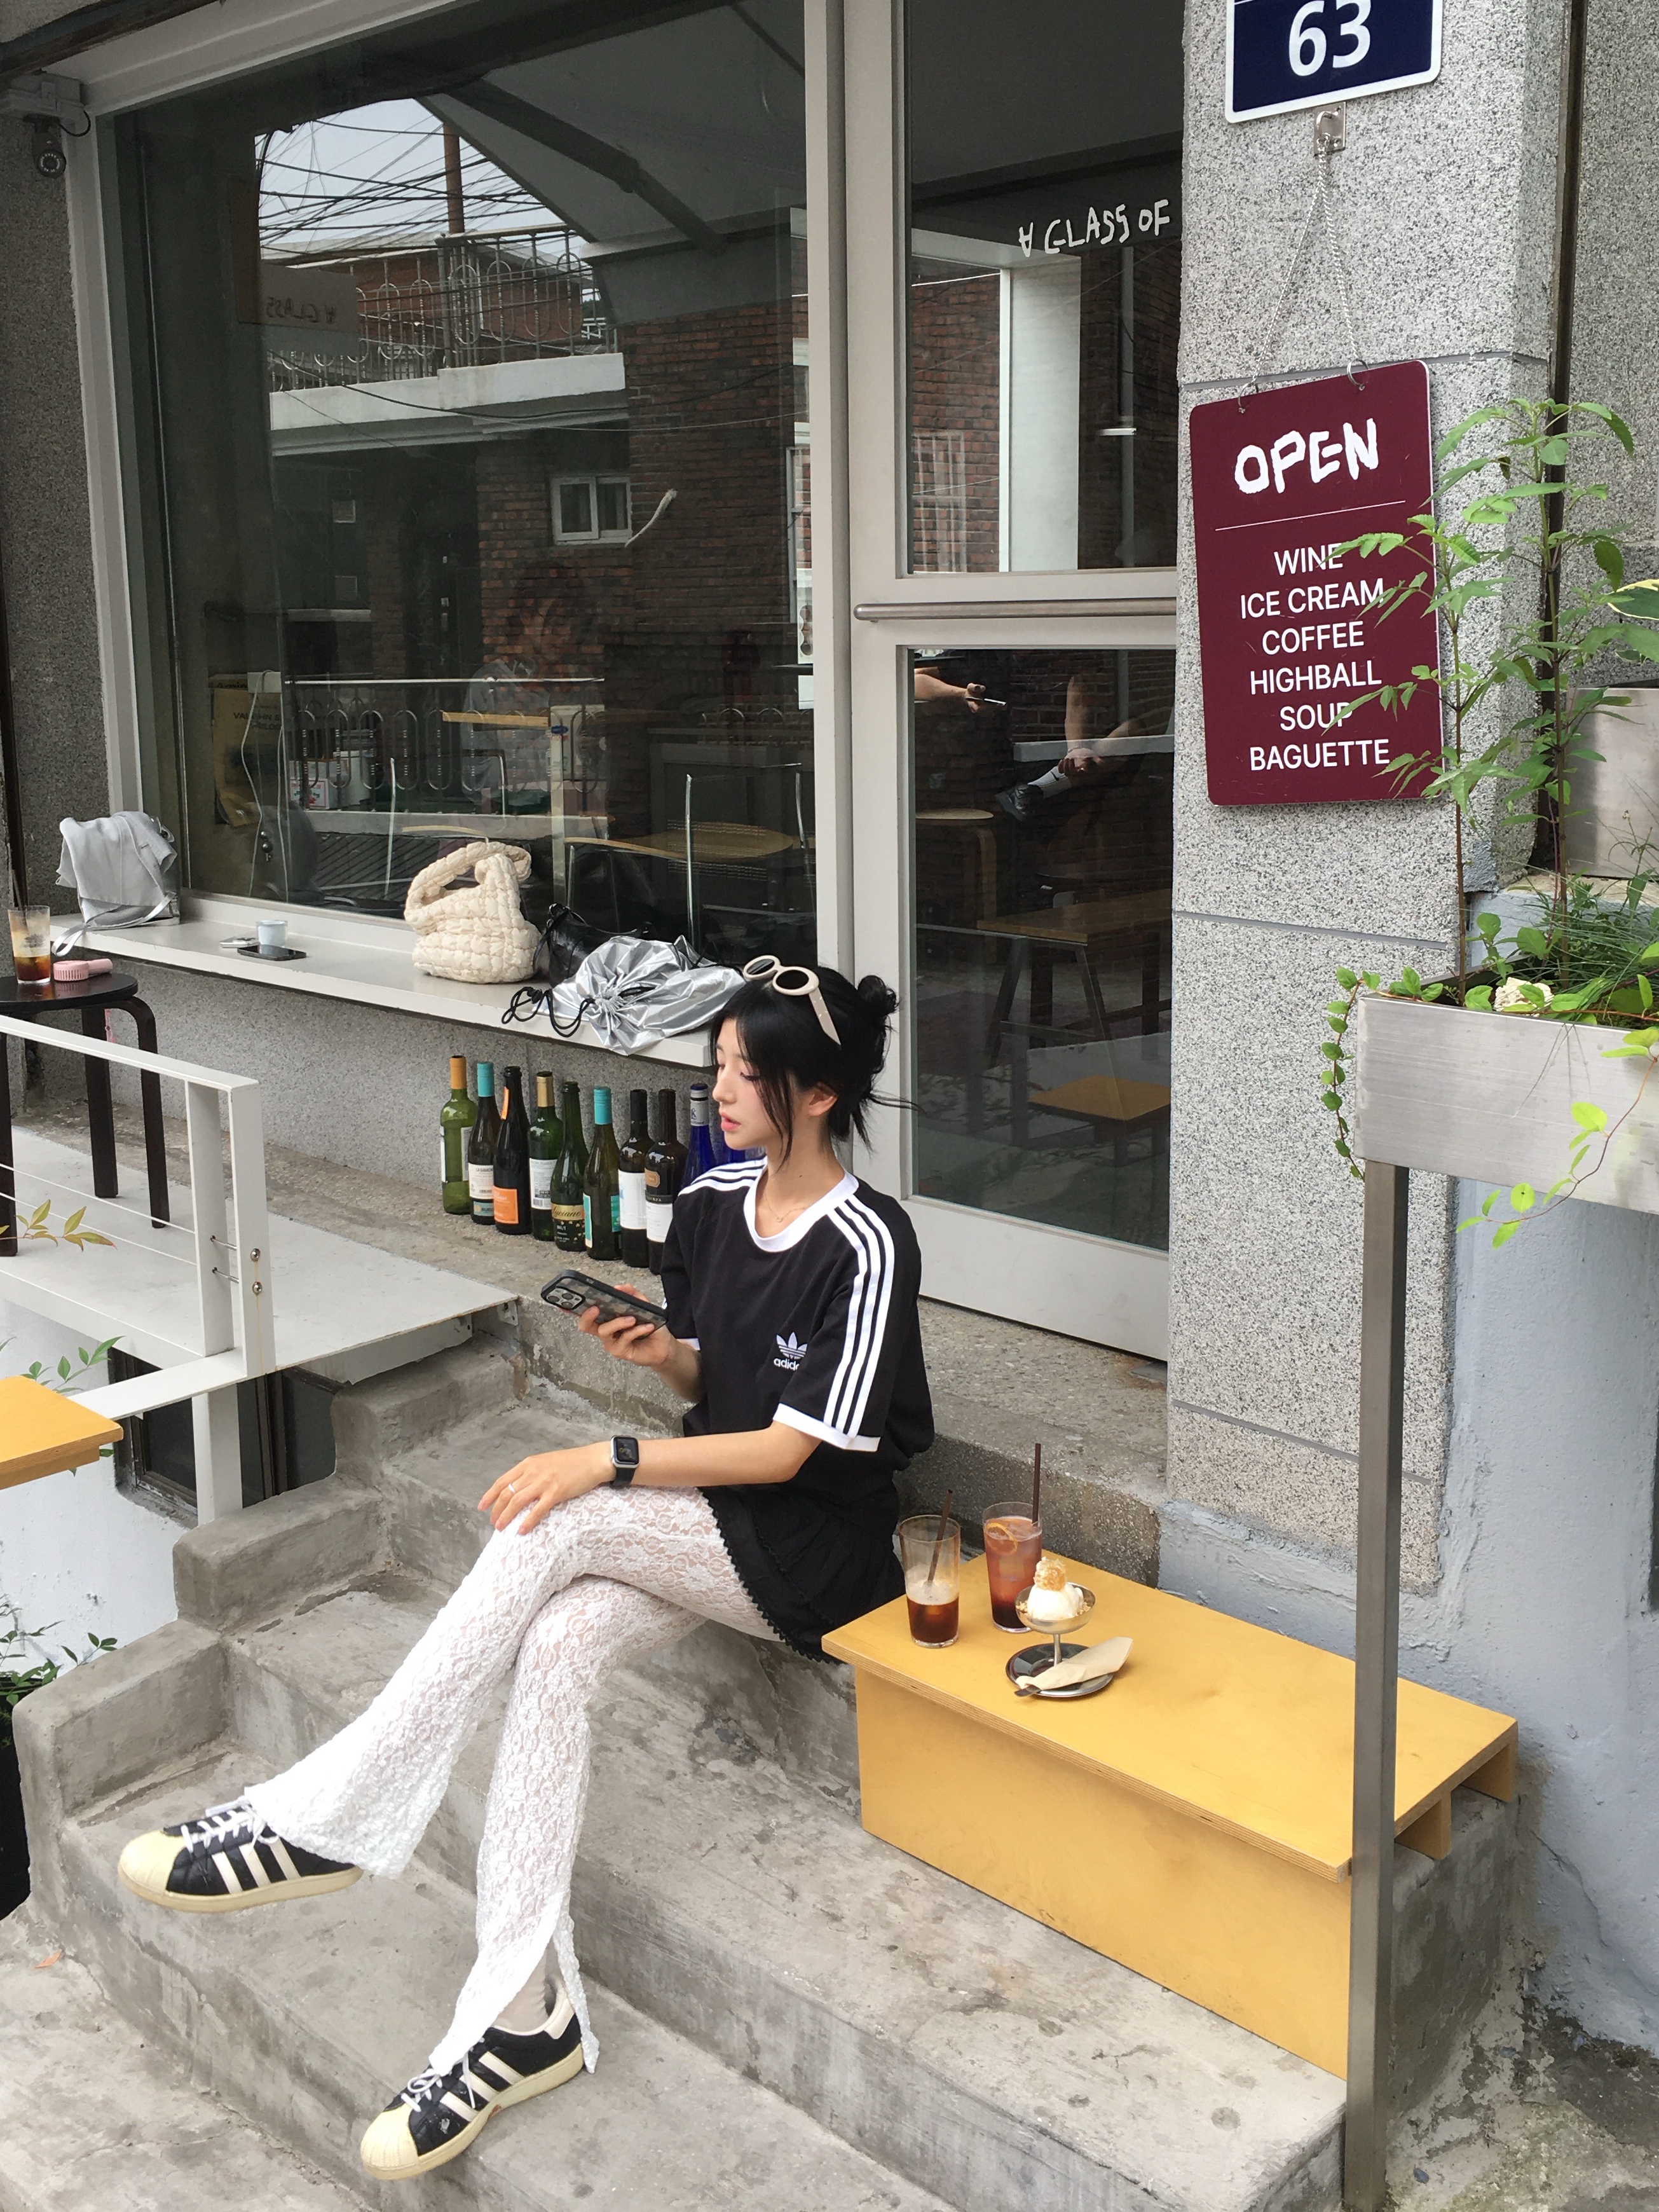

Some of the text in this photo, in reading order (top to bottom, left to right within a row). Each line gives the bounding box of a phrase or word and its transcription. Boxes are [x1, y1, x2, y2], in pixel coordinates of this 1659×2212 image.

[1288, 0, 1372, 76] 63
[1044, 203, 1130, 254] GLASS
[1138, 199, 1170, 236] OF
[1234, 418, 1379, 494] OPEN
[1273, 542, 1343, 575] WINE
[1241, 577, 1384, 619] ICE CREAM
[1262, 621, 1365, 656] COFFEE
[1250, 660, 1382, 695] HIGHBALL
[1280, 701, 1353, 731] SOUP
[1250, 738, 1390, 771] BAGUETTE
